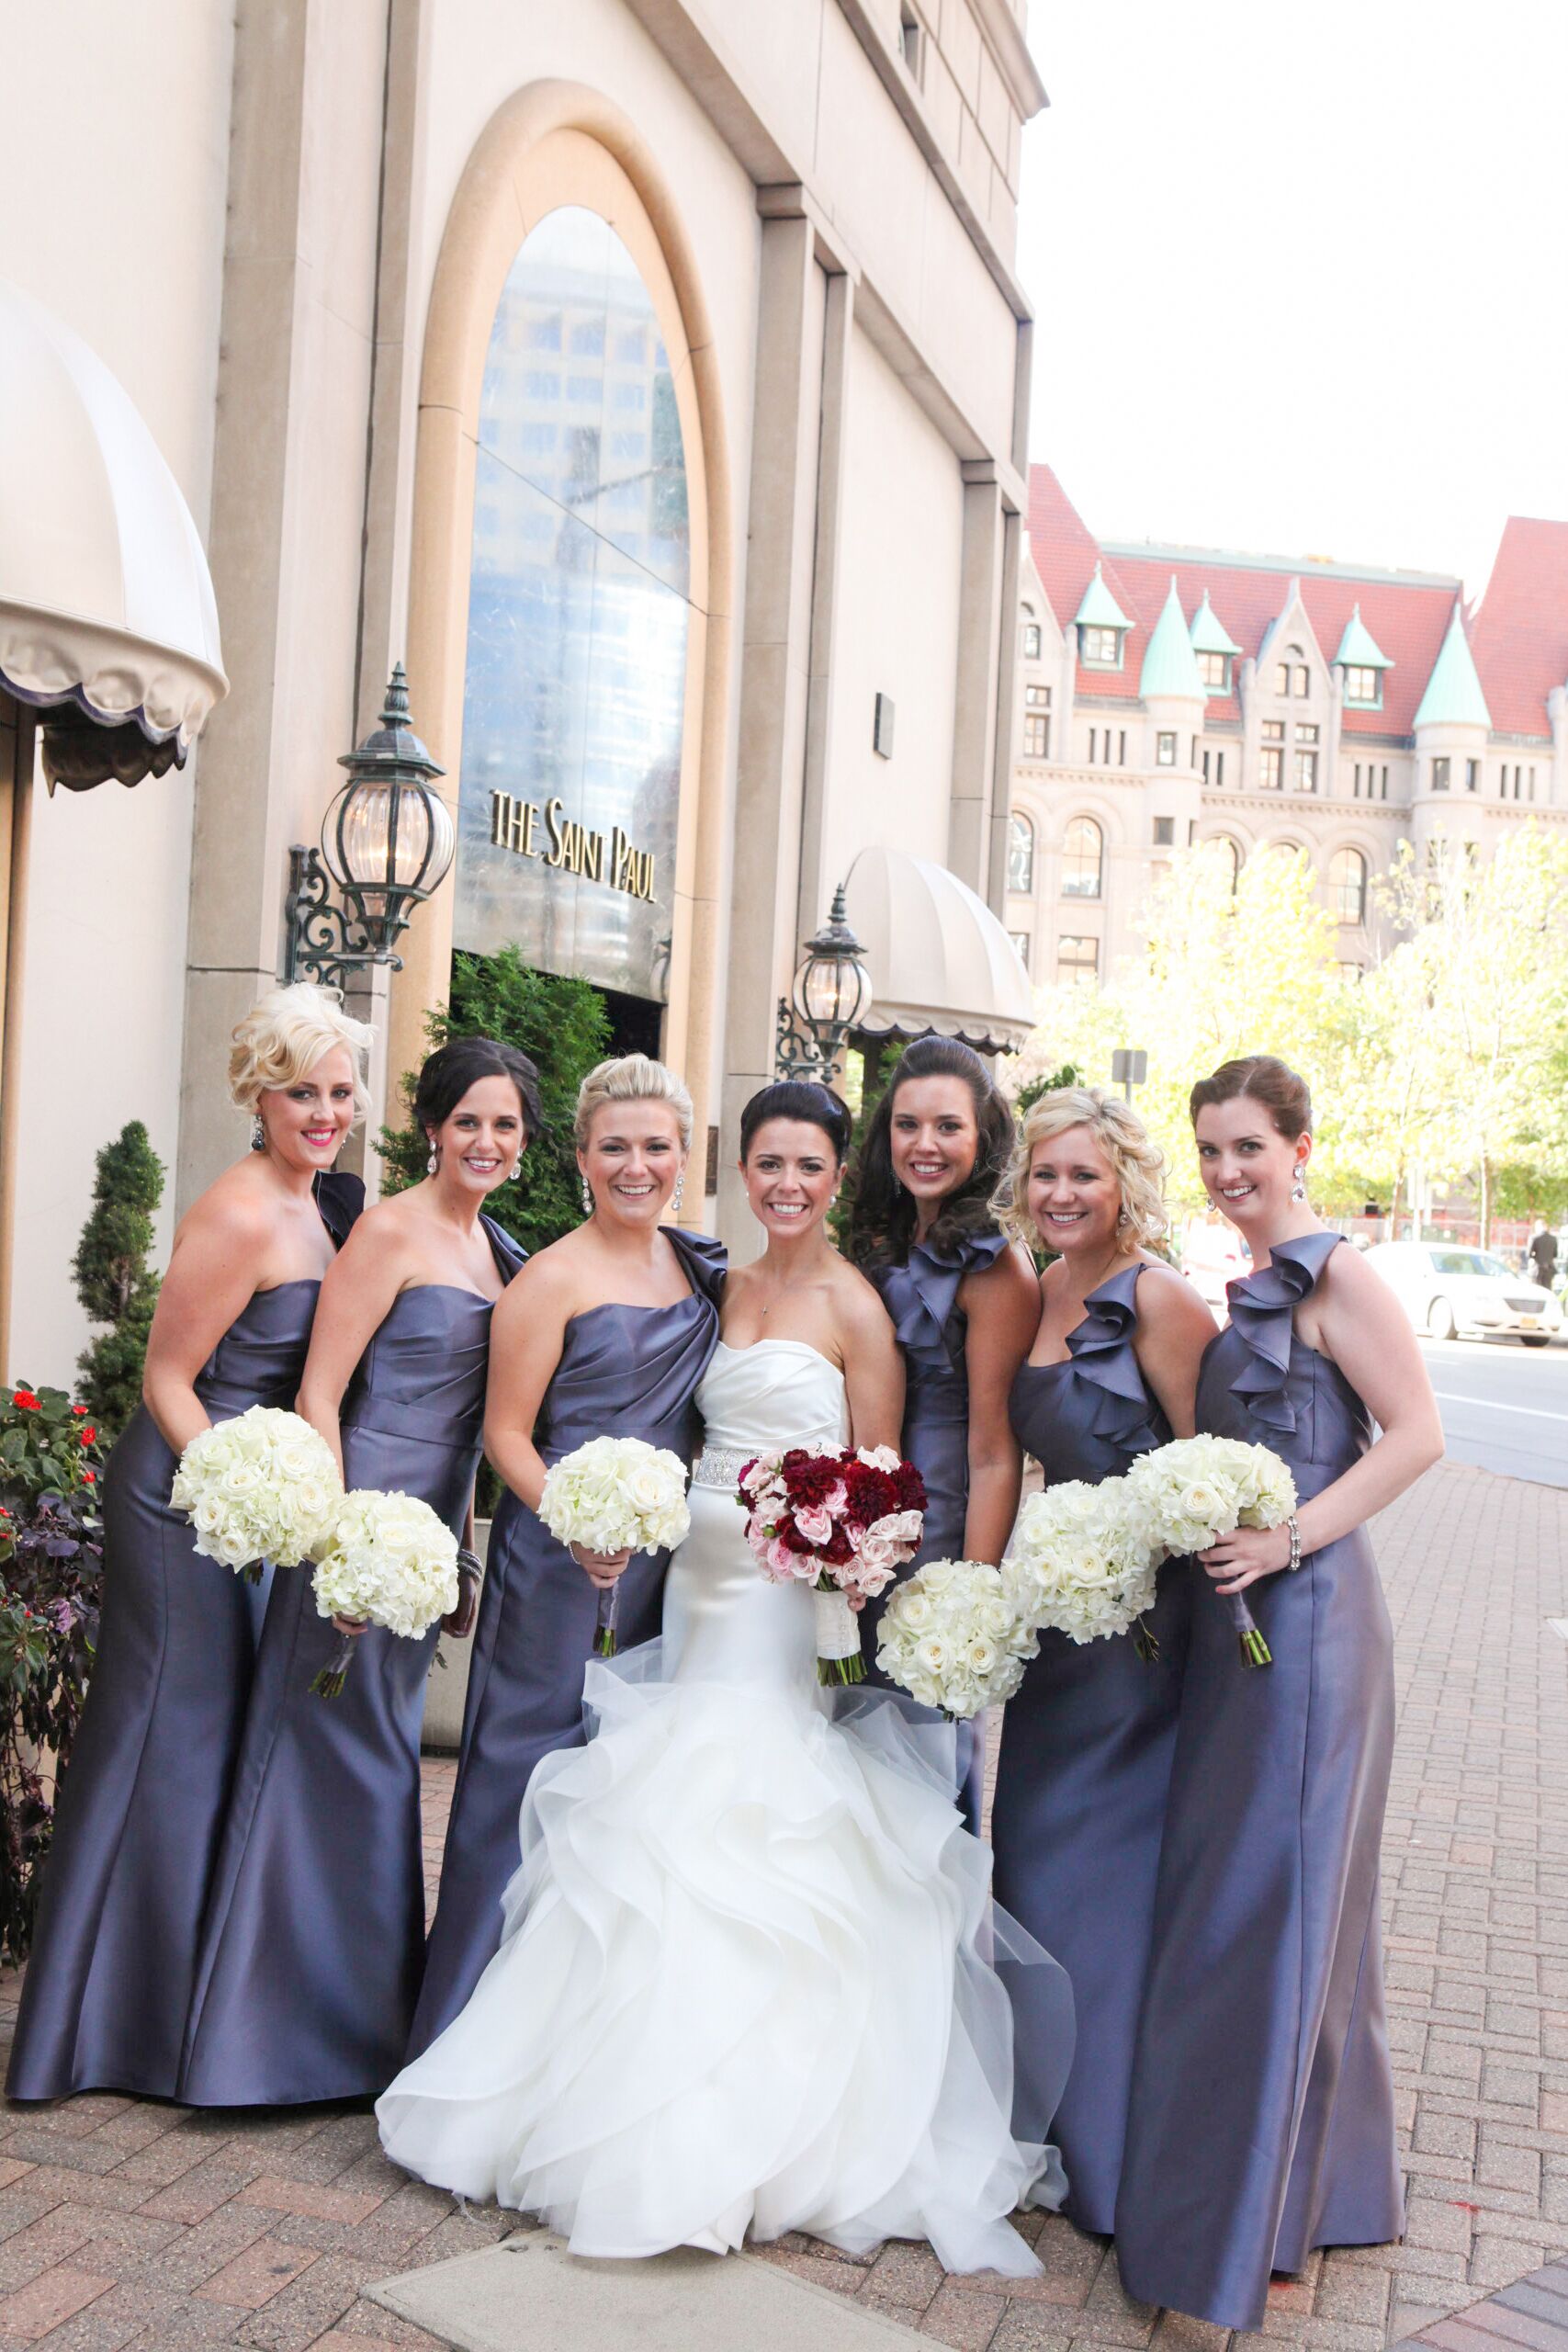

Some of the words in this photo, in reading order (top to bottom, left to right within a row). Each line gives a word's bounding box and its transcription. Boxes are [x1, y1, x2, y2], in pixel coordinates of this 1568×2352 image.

[489, 788, 539, 857] THE
[541, 797, 607, 882] SAINT
[610, 826, 657, 903] PAUL
